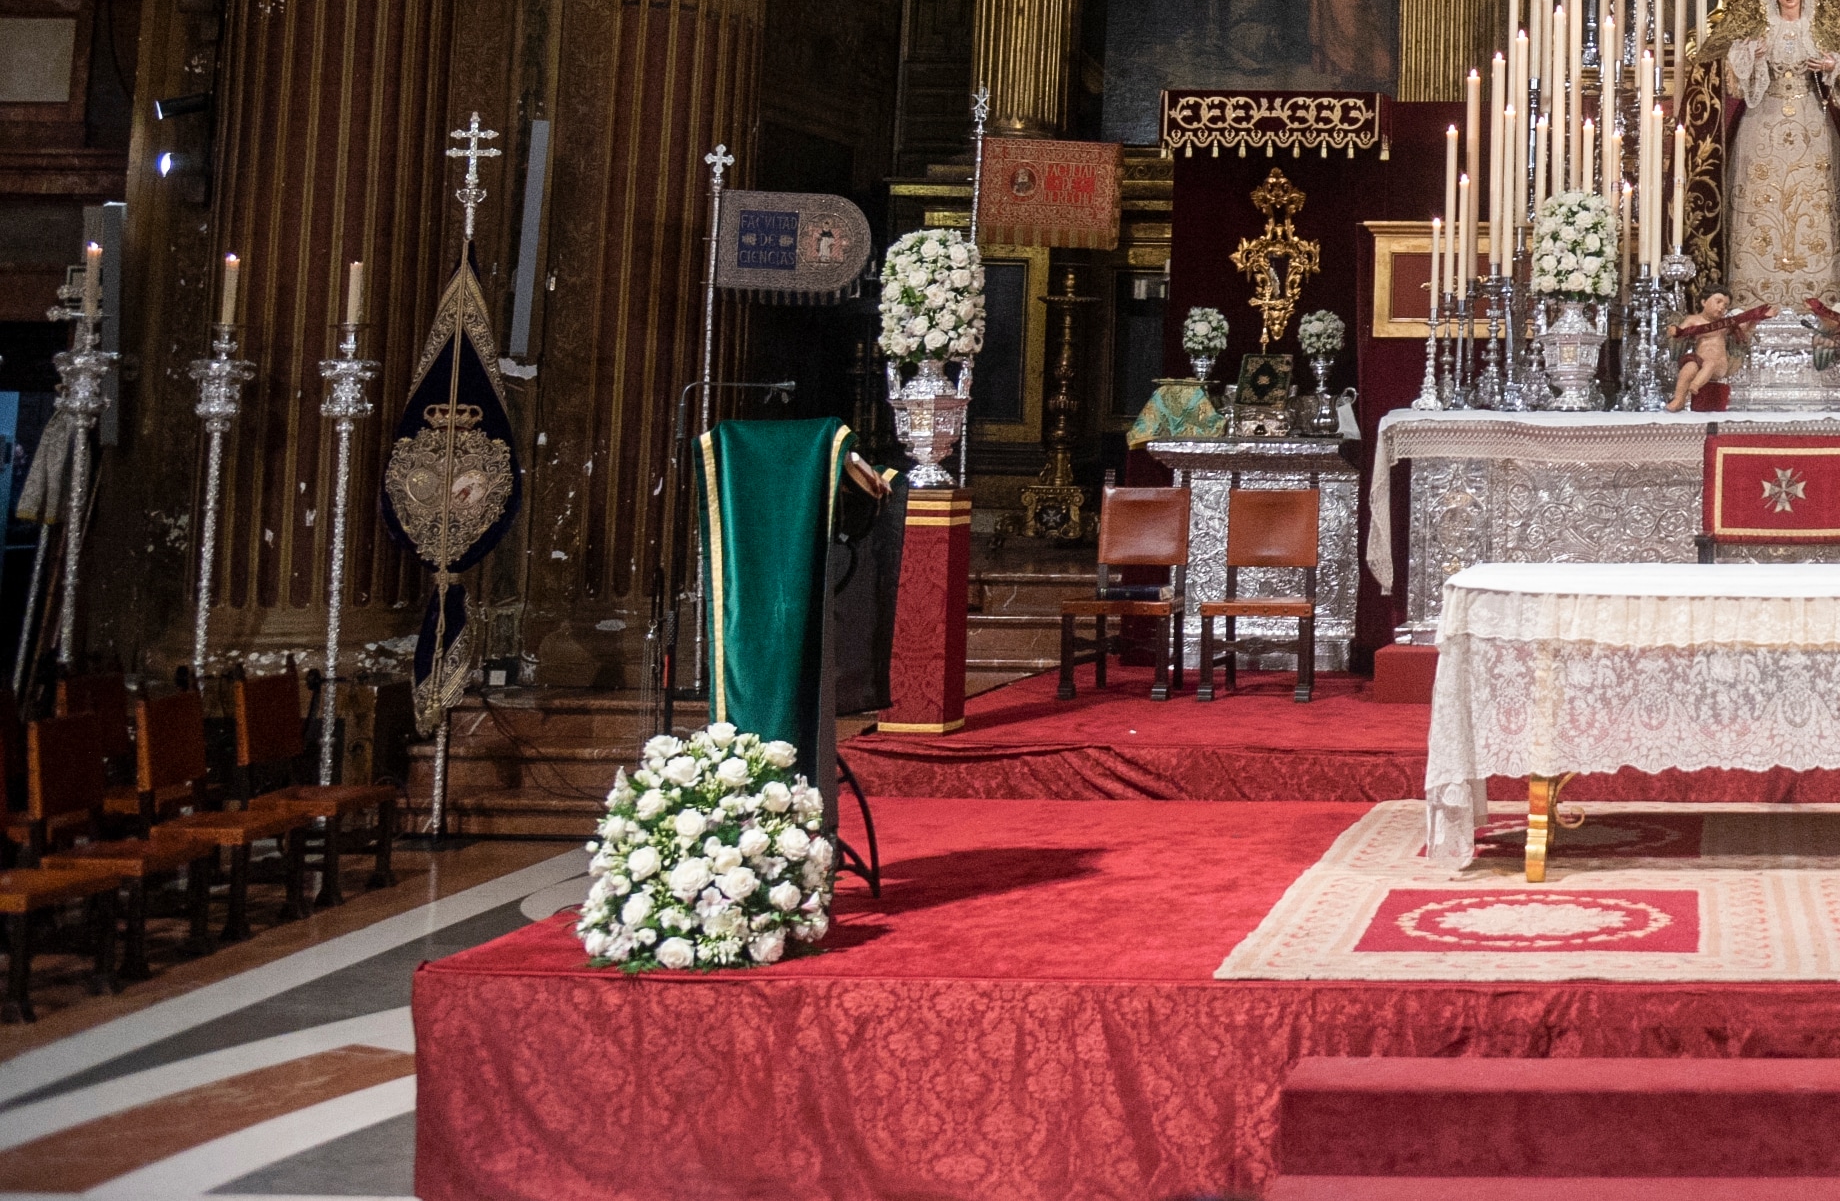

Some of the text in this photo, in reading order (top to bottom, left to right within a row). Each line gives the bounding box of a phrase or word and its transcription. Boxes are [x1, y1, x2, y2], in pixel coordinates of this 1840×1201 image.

[759, 233, 777, 247] DE
[739, 250, 796, 266] CIENCIAS
[1704, 318, 1736, 331] SEDES
